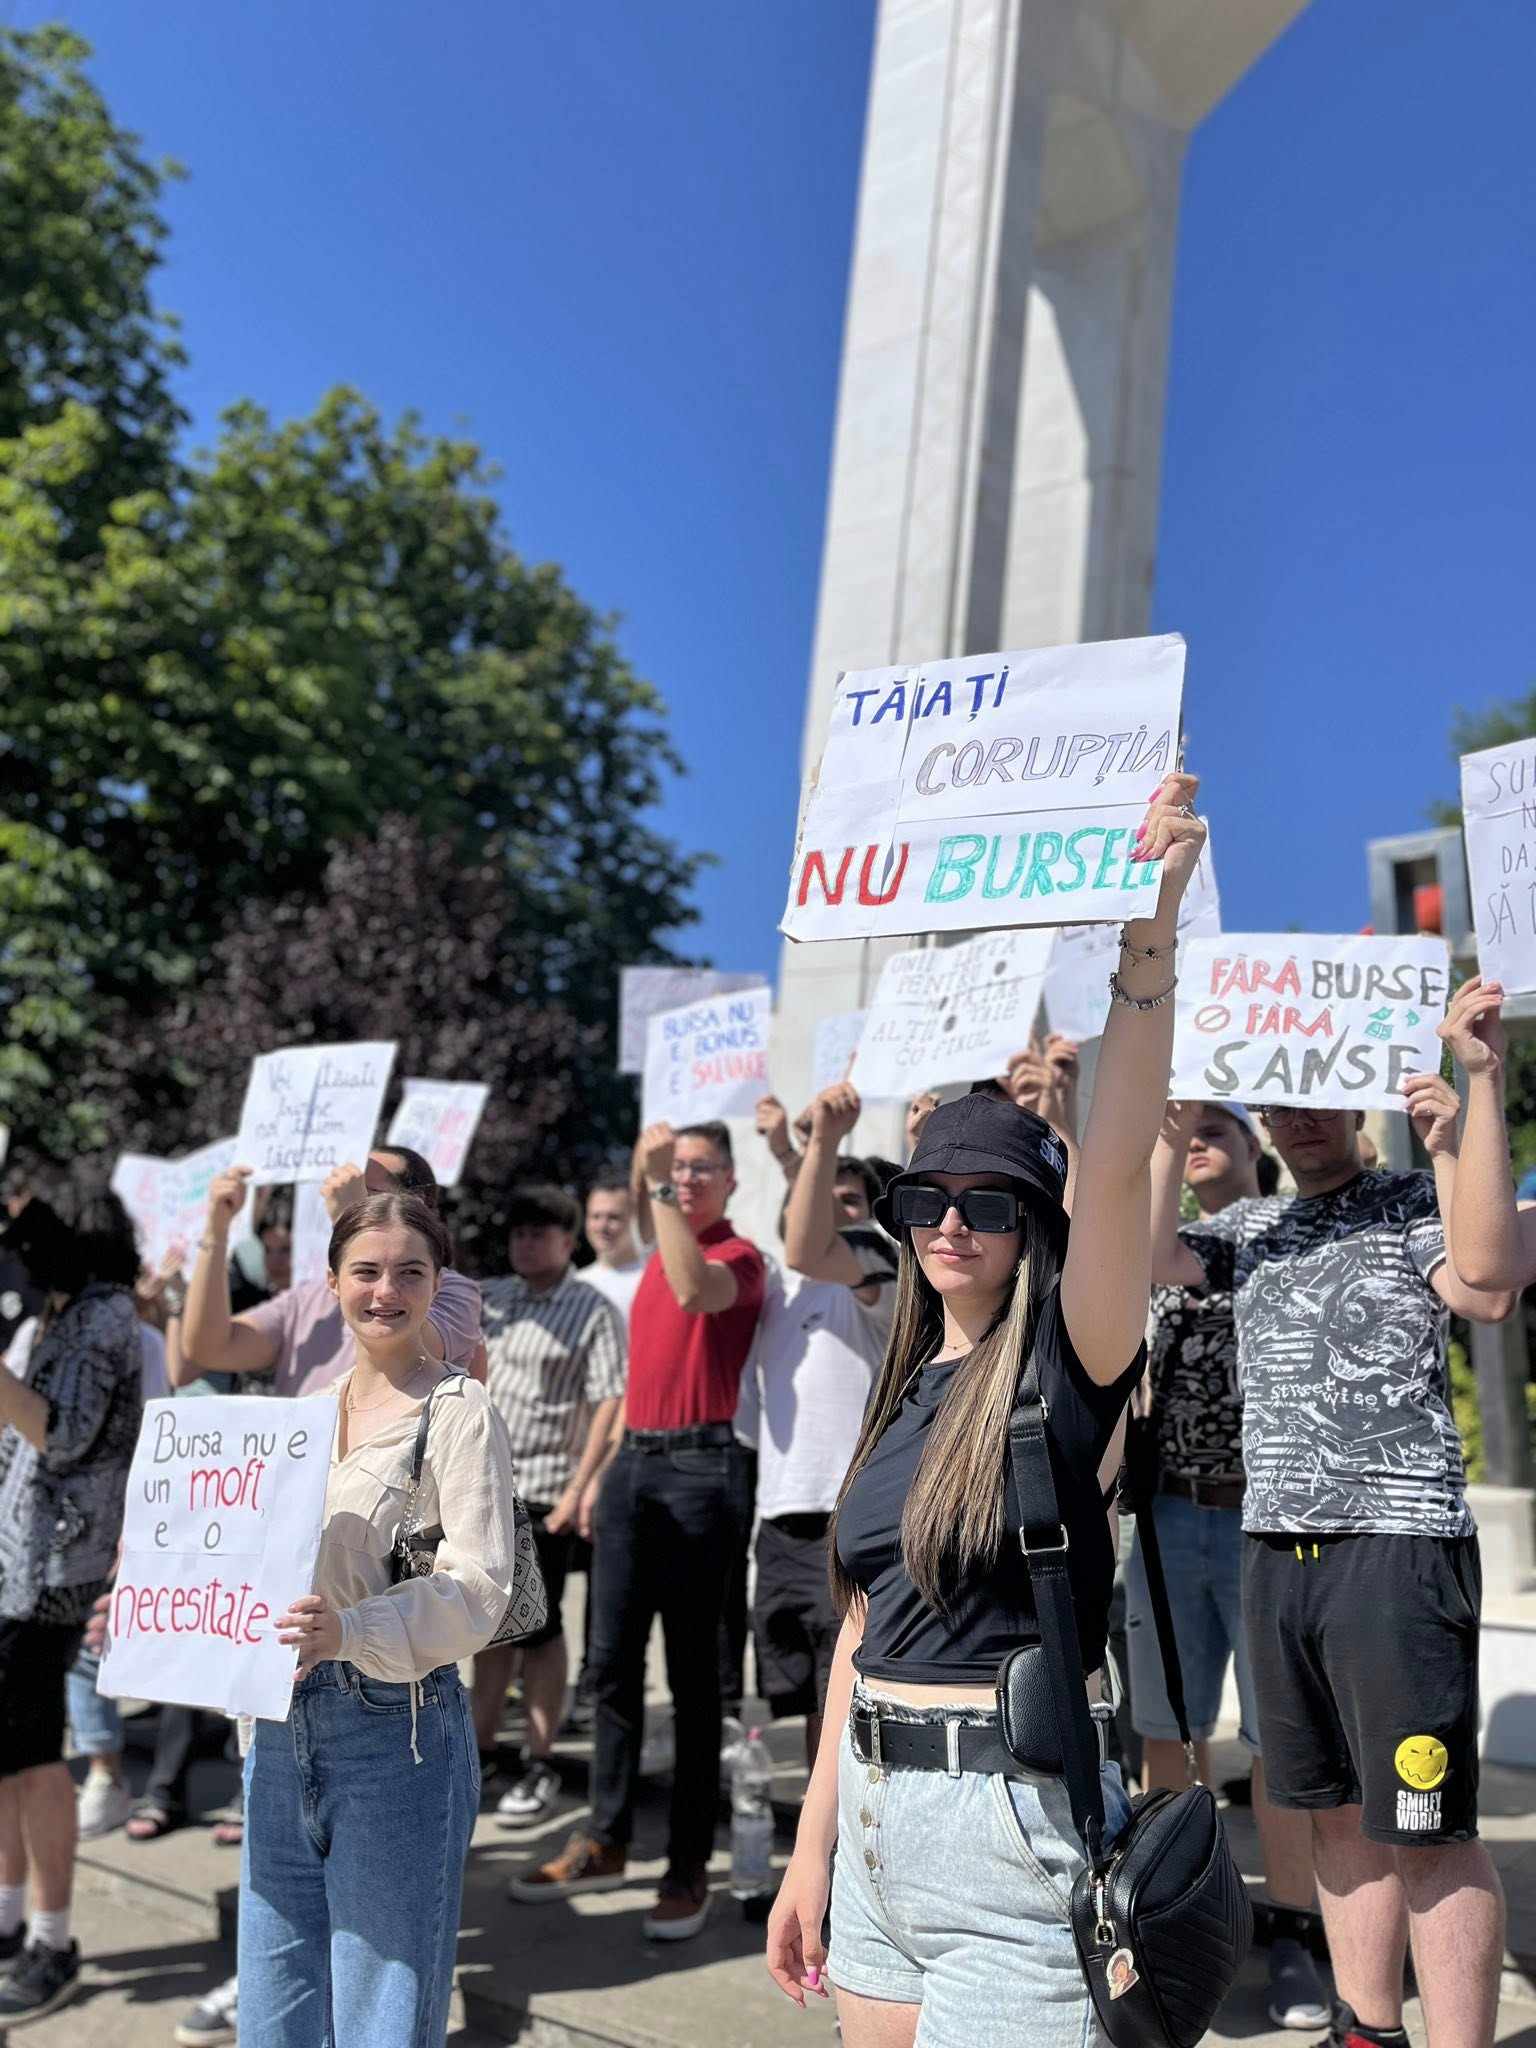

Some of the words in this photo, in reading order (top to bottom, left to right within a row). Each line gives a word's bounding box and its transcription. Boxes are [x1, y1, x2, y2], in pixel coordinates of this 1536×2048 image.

[916, 725, 1171, 795] CORUPȚIA
[1487, 755, 1536, 804] SU
[795, 842, 909, 907] NU
[1502, 842, 1536, 874] DA
[1311, 960, 1447, 1008] BURSE
[153, 1410, 222, 1464] Bursa
[243, 1431, 276, 1457] nu
[288, 1430, 308, 1459] e
[144, 1477, 170, 1504] un
[154, 1520, 169, 1548] e
[204, 1521, 222, 1549] o
[113, 1577, 269, 1645] necesitate
[1396, 1808, 1442, 1830] WORLD
[1397, 1789, 1442, 1812] SMILEY
